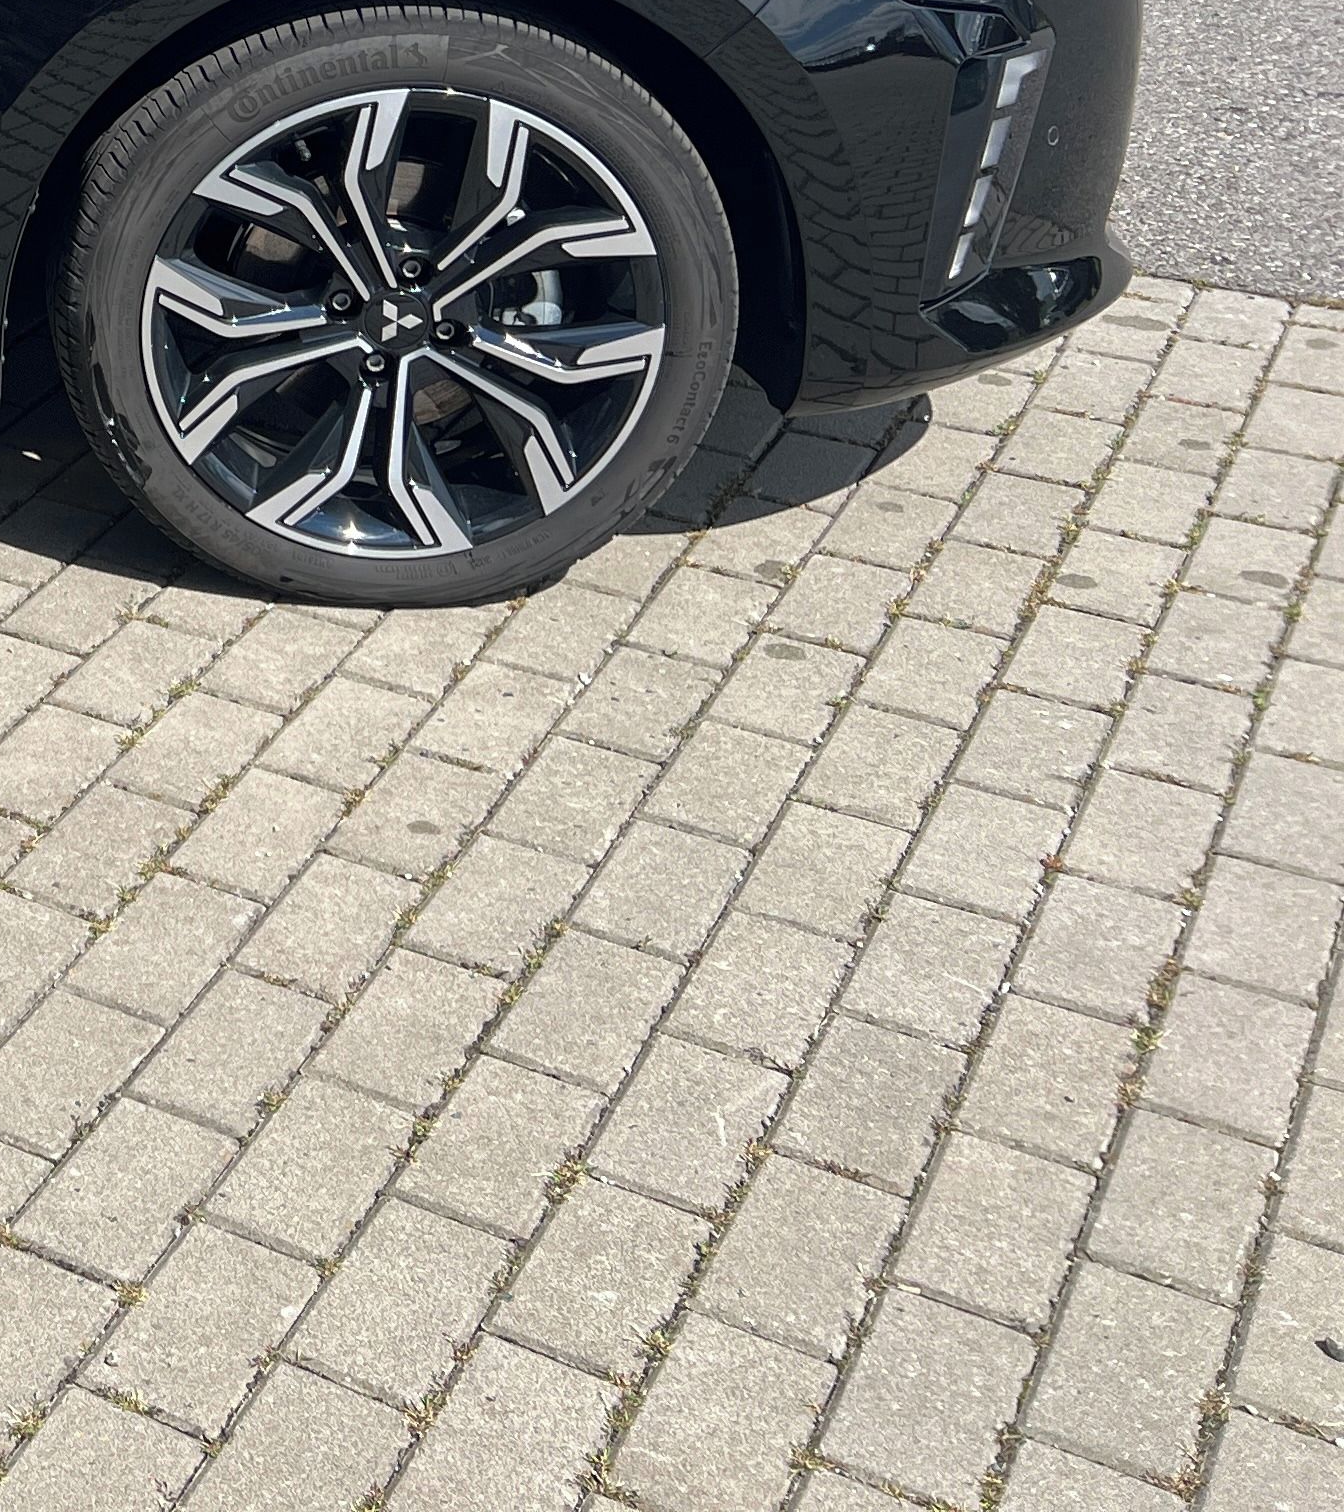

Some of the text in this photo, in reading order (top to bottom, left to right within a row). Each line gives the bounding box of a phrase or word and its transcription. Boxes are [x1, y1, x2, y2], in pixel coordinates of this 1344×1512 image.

[226, 45, 399, 122] Continental
[666, 341, 713, 445] EcoContact 6
